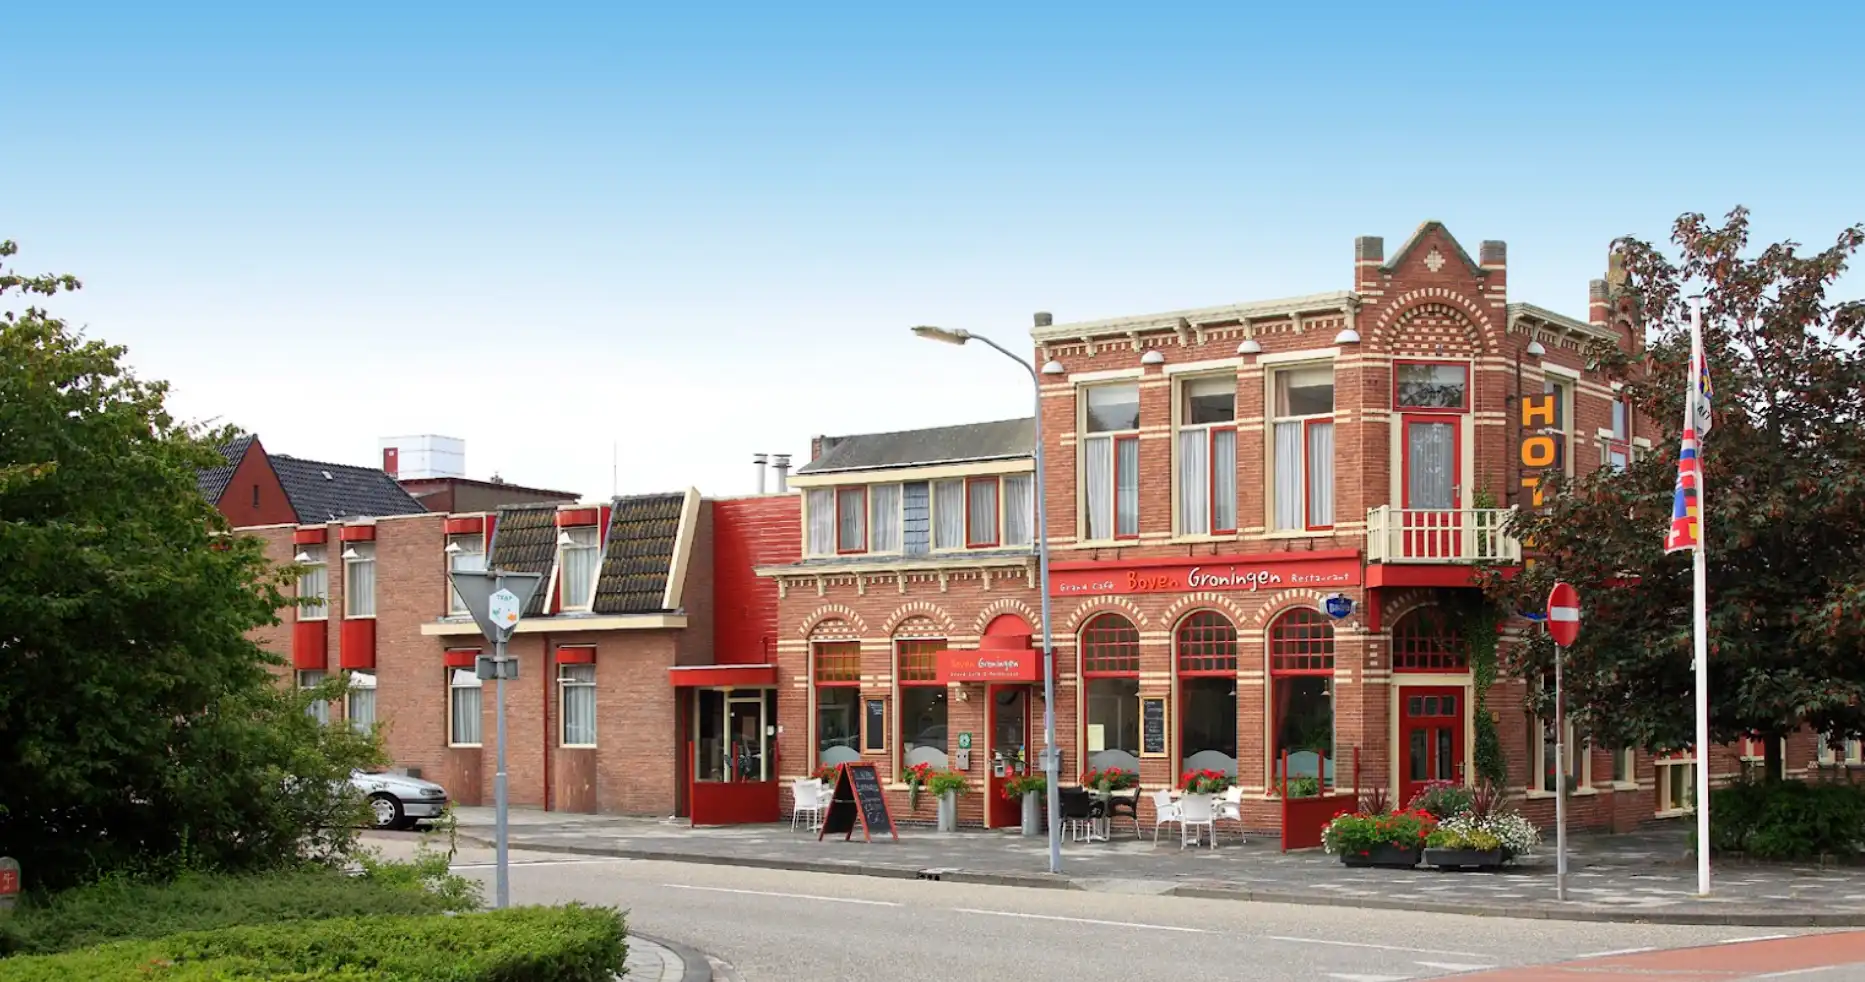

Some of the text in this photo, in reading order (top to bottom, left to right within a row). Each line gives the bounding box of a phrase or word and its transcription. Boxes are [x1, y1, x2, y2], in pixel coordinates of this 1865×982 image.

[1059, 582, 1088, 592] Grand
[1126, 570, 1181, 591] Boven
[1188, 566, 1282, 592] Groningen
[1291, 572, 1349, 583] Restaurant
